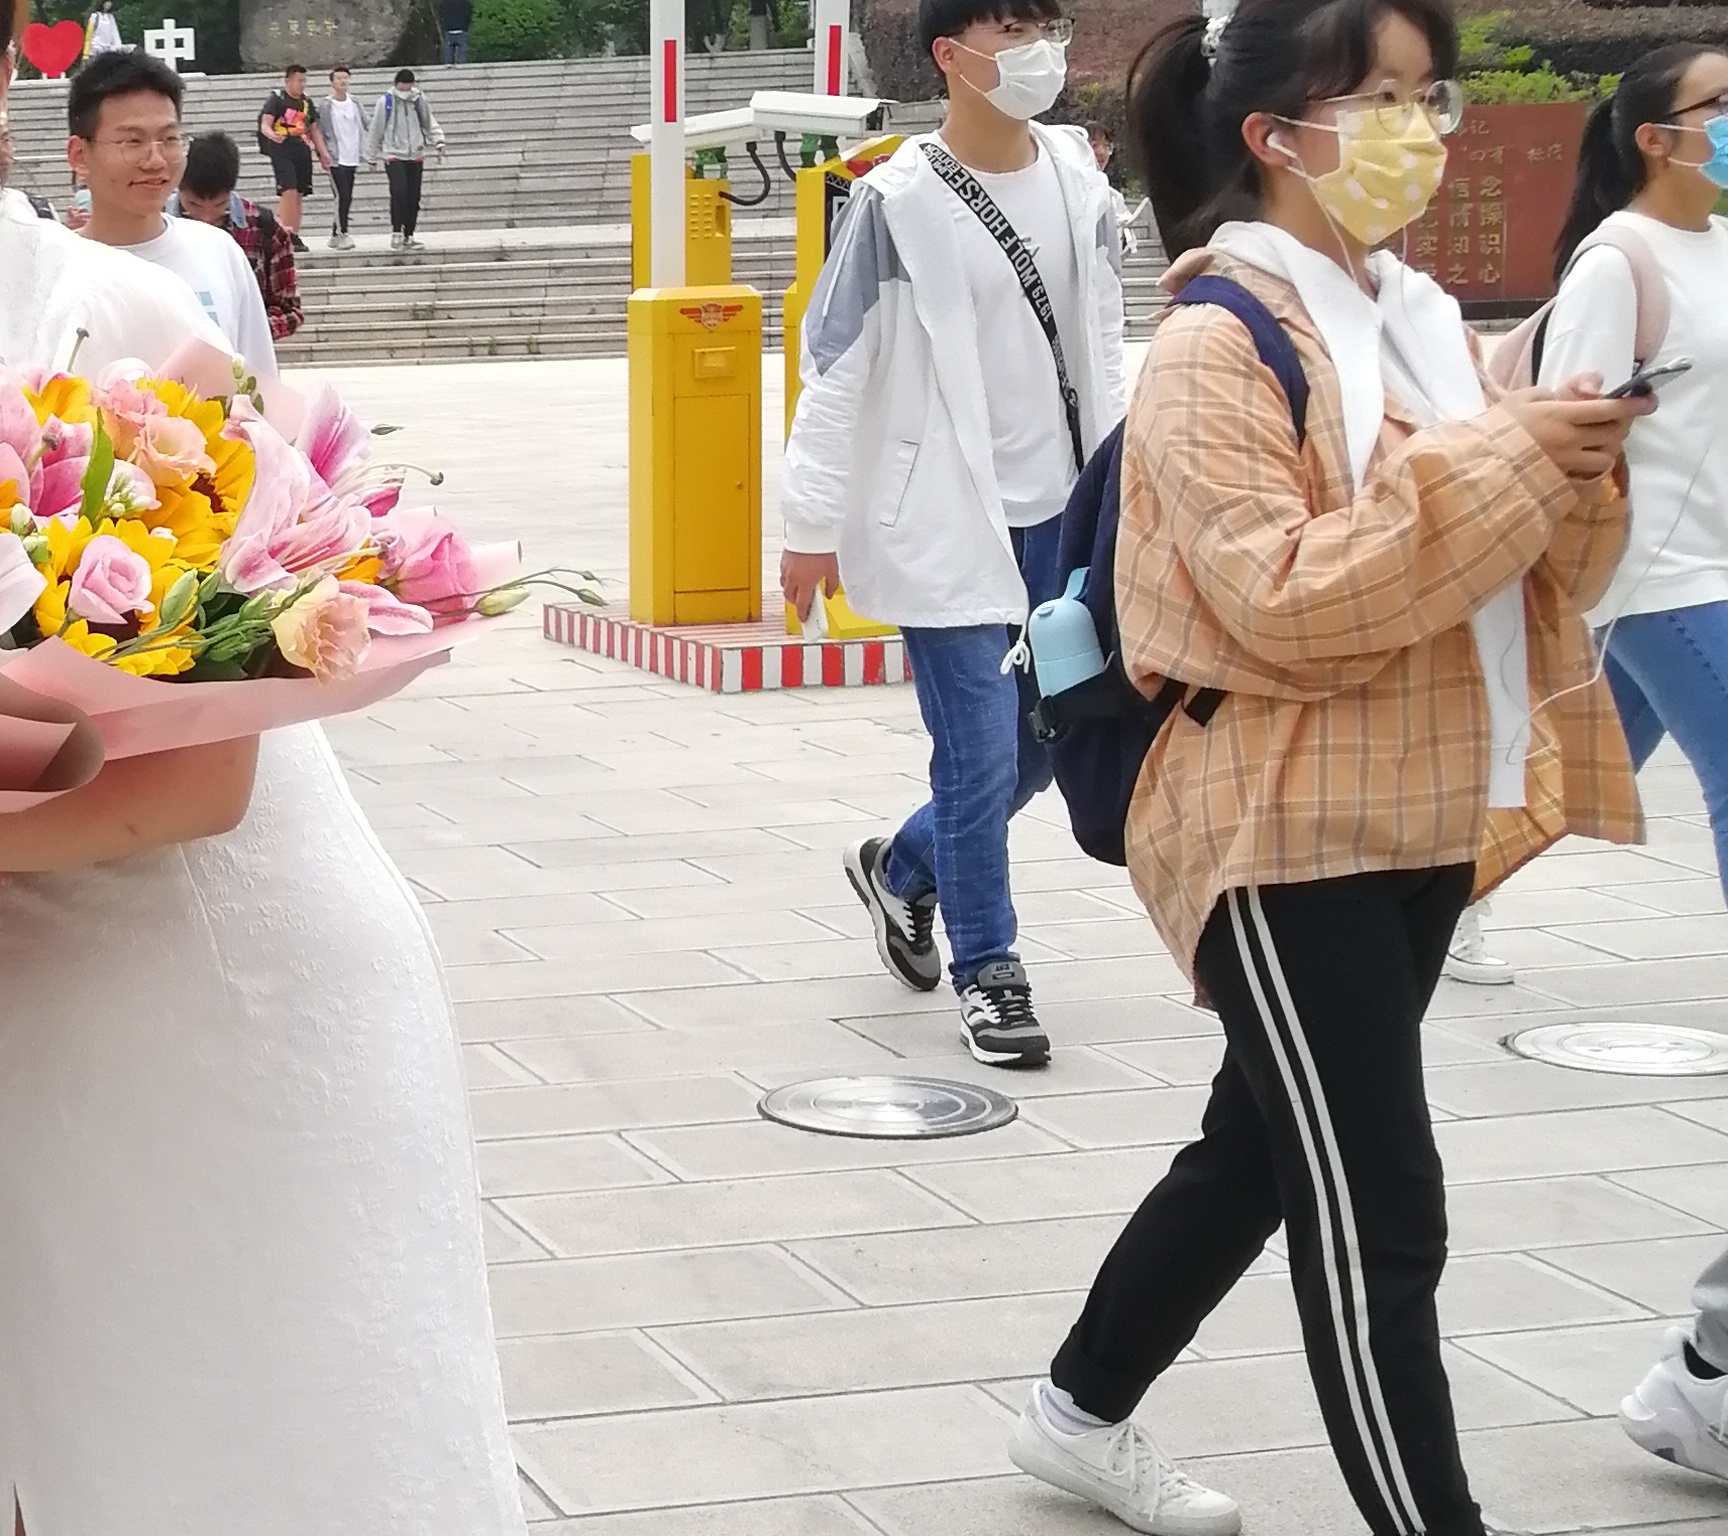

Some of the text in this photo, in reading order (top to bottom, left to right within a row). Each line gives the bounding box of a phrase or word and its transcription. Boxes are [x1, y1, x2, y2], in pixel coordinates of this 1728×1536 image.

[143, 18, 196, 73] 中
[948, 169, 1009, 237] HORSE
[1434, 175, 1503, 199] 信念
